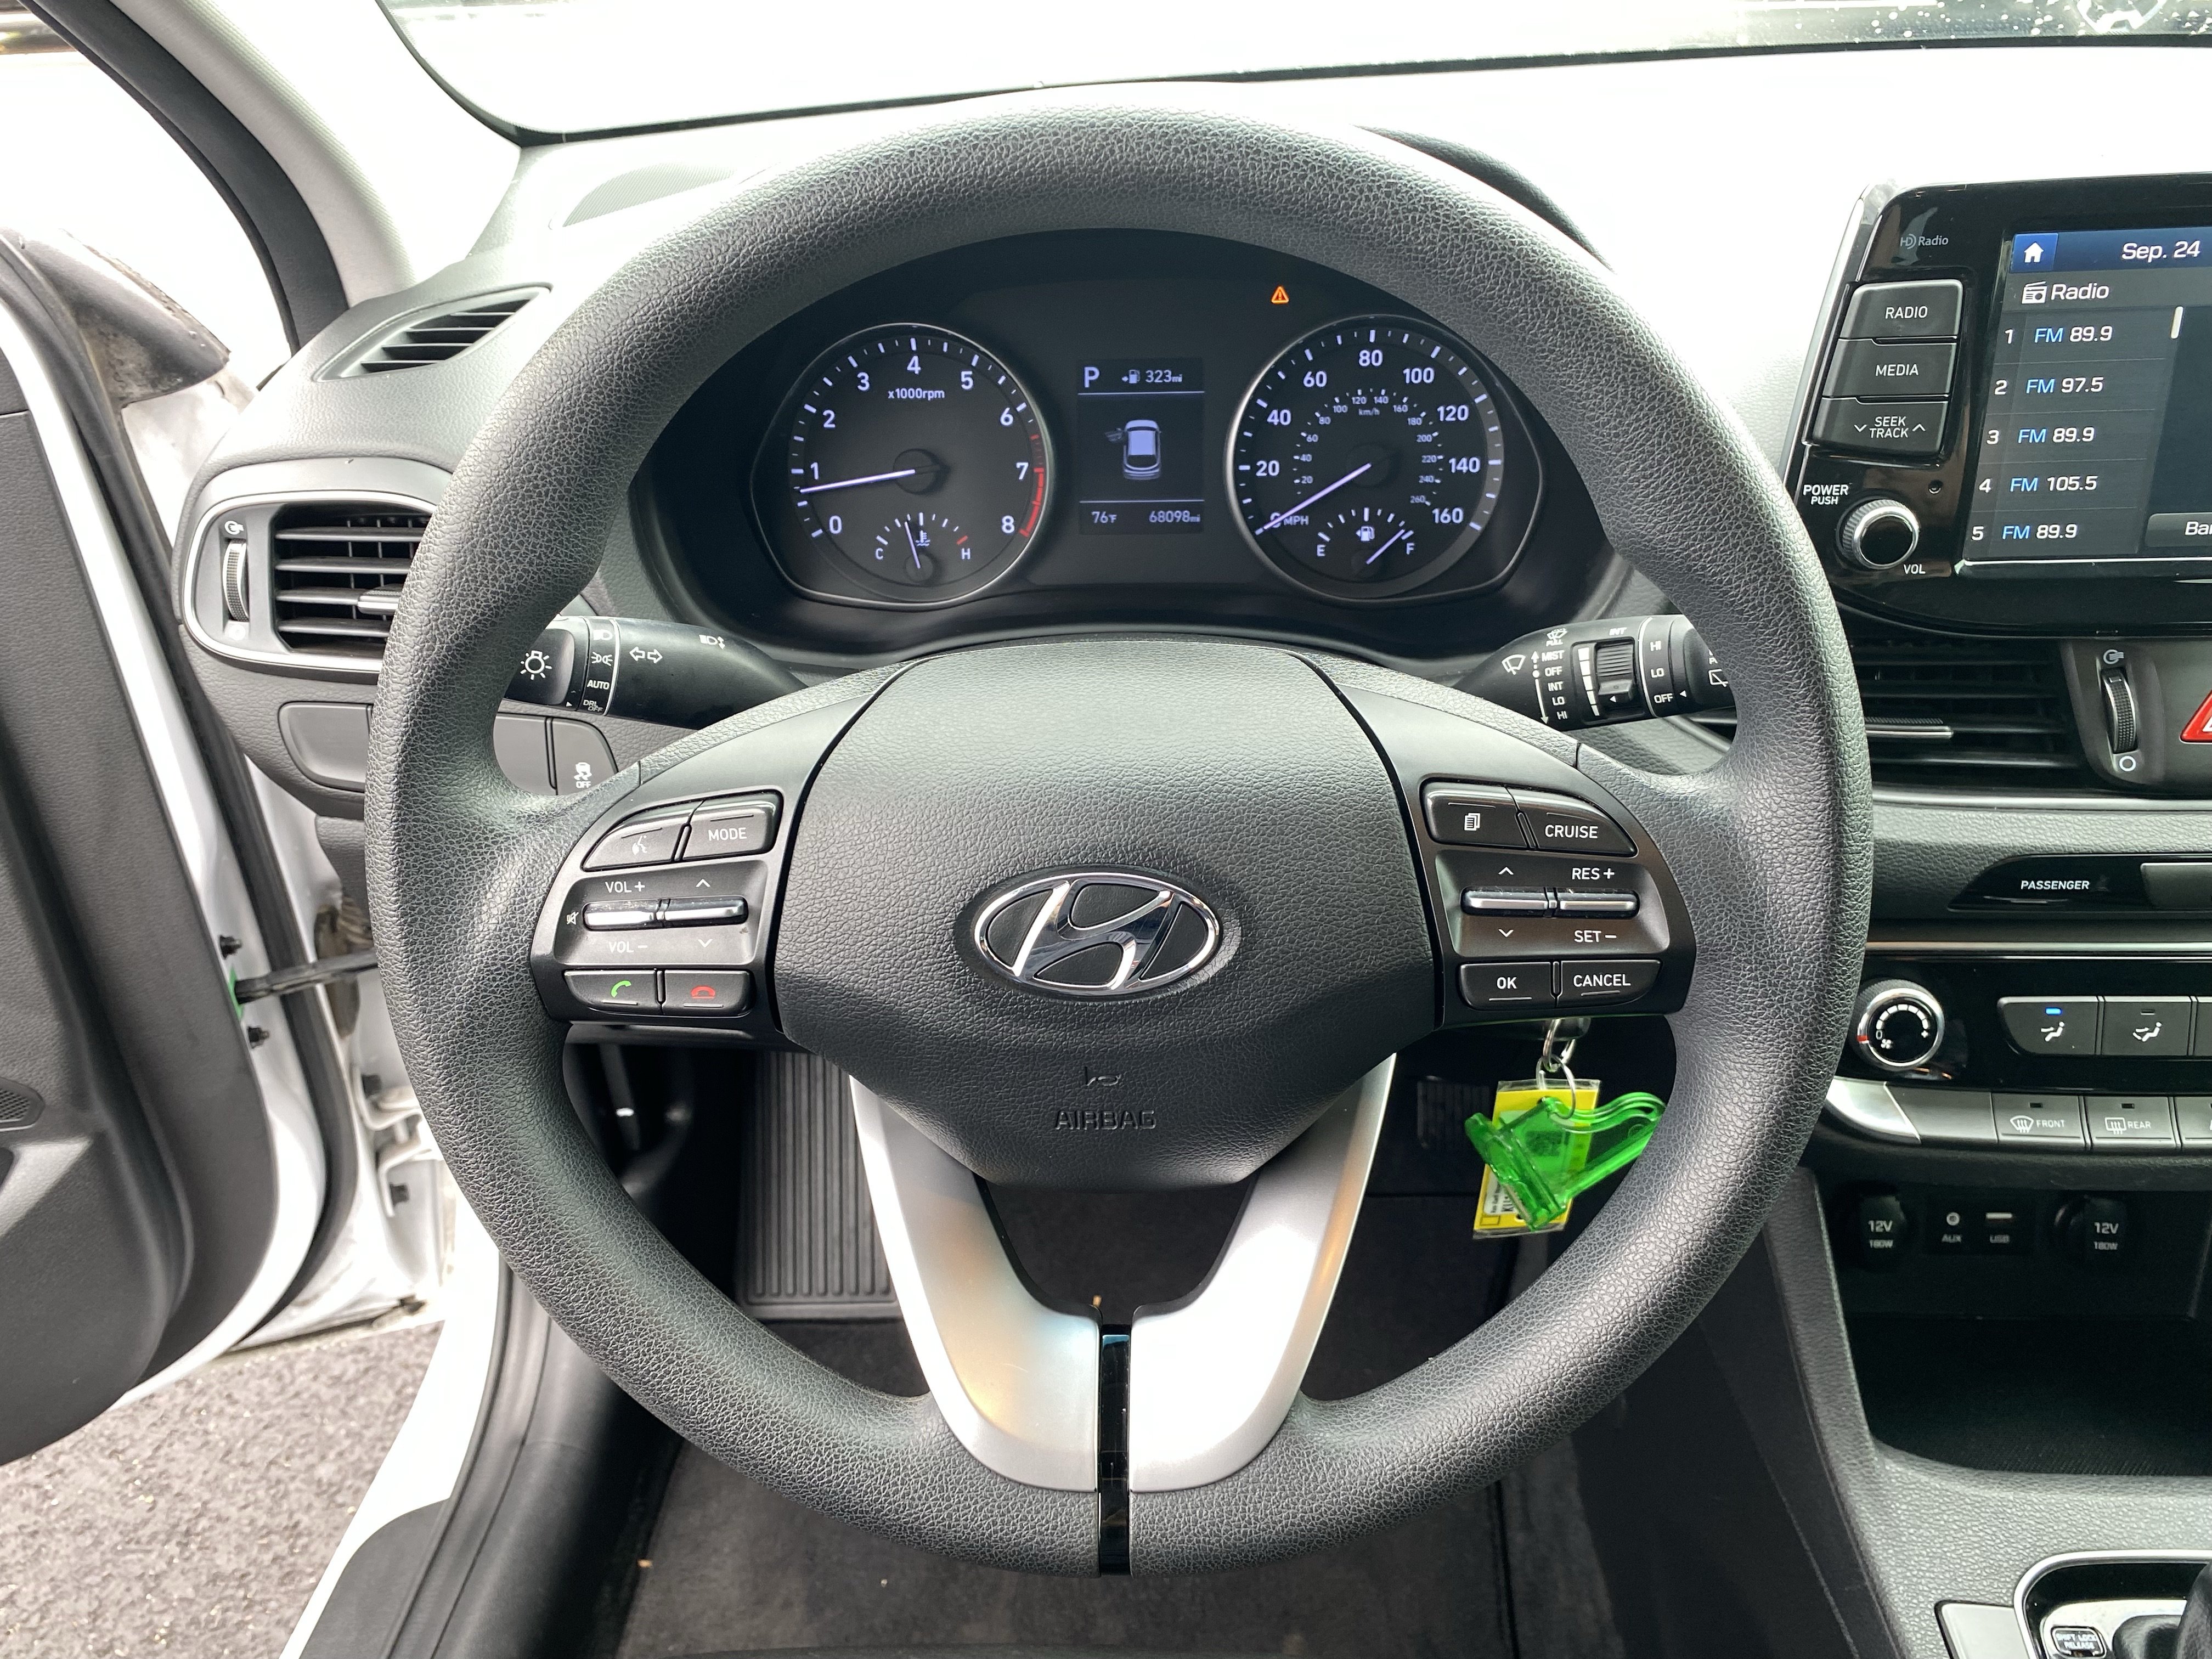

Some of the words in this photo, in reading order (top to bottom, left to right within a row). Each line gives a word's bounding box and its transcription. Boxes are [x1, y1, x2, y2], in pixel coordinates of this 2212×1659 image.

[1900, 234, 1917, 249] HD
[1918, 235, 1949, 246] Radio
[2122, 242, 2167, 263] Sep.
[2174, 240, 2200, 258] 24
[2051, 283, 2109, 301] Radio
[1885, 306, 1928, 319] RADIO
[2005, 329, 2013, 344] 1
[2034, 328, 2064, 343] FM
[2069, 325, 2113, 342] 89.9
[907, 356, 921, 374] 4
[1359, 350, 1383, 366] 80
[1084, 366, 1100, 387] P
[1403, 368, 1435, 384] 100
[1875, 364, 1918, 376] MEDIA
[857, 373, 870, 391] 3
[961, 371, 973, 390] 5
[1304, 371, 1327, 387] 60
[1995, 380, 2007, 394] 2
[2026, 379, 2055, 394] FM
[2061, 377, 2104, 393] 97.5
[888, 388, 945, 400] x1000rpm
[823, 410, 836, 428] 2
[1000, 408, 1013, 426] 6
[1267, 410, 1291, 425] 40
[1437, 405, 1469, 421] 120
[1874, 416, 1906, 426] SEEK
[1869, 428, 1909, 438] TRACK
[1987, 430, 1999, 444] 3
[2018, 428, 2047, 443] FM
[2052, 427, 2095, 442] 89.9
[810, 462, 819, 479] 1
[1016, 462, 1029, 480] 7
[1256, 461, 1280, 476] 20
[1449, 457, 1480, 473] 140
[1301, 476, 1313, 484] 20
[1979, 478, 1991, 493] 4
[2010, 477, 2038, 492] FM
[2047, 476, 2098, 491] 105.5
[1803, 484, 1849, 495] POWER
[1811, 496, 1838, 505] PUSH
[1284, 516, 1309, 526] MPH
[1432, 508, 1463, 524] 160
[830, 516, 842, 534] 0
[1002, 516, 1014, 534] 8
[1972, 526, 1984, 540] 5
[2002, 526, 2030, 539] FM
[2036, 524, 2078, 539] 89.9
[2185, 521, 2212, 535] Ba
[875, 549, 883, 560] C
[961, 549, 970, 559] H
[1317, 546, 1325, 556] E
[1406, 544, 1414, 554] F
[1904, 564, 1926, 574] VOL
[1650, 641, 1661, 651] HI
[1542, 650, 1565, 662] MIST
[1544, 667, 1562, 677] OFF
[1651, 668, 1664, 679] LO
[586, 680, 610, 690] AUTO
[1548, 681, 1563, 692] INT
[1552, 697, 1565, 706] LO
[1654, 692, 1673, 704] OFF
[1556, 710, 1568, 720] HI
[708, 828, 747, 842] MODE
[1545, 825, 1598, 839] CRUISE
[2021, 880, 2090, 890] PASSENGER
[1497, 977, 1517, 989] OK
[1573, 974, 1631, 987] CANCEL
[1055, 1110, 1156, 1130] AIRBAG
[2036, 1120, 2065, 1128] FRONT
[1868, 1220, 1893, 1232] 12V
[2094, 1222, 2119, 1234] 12V
